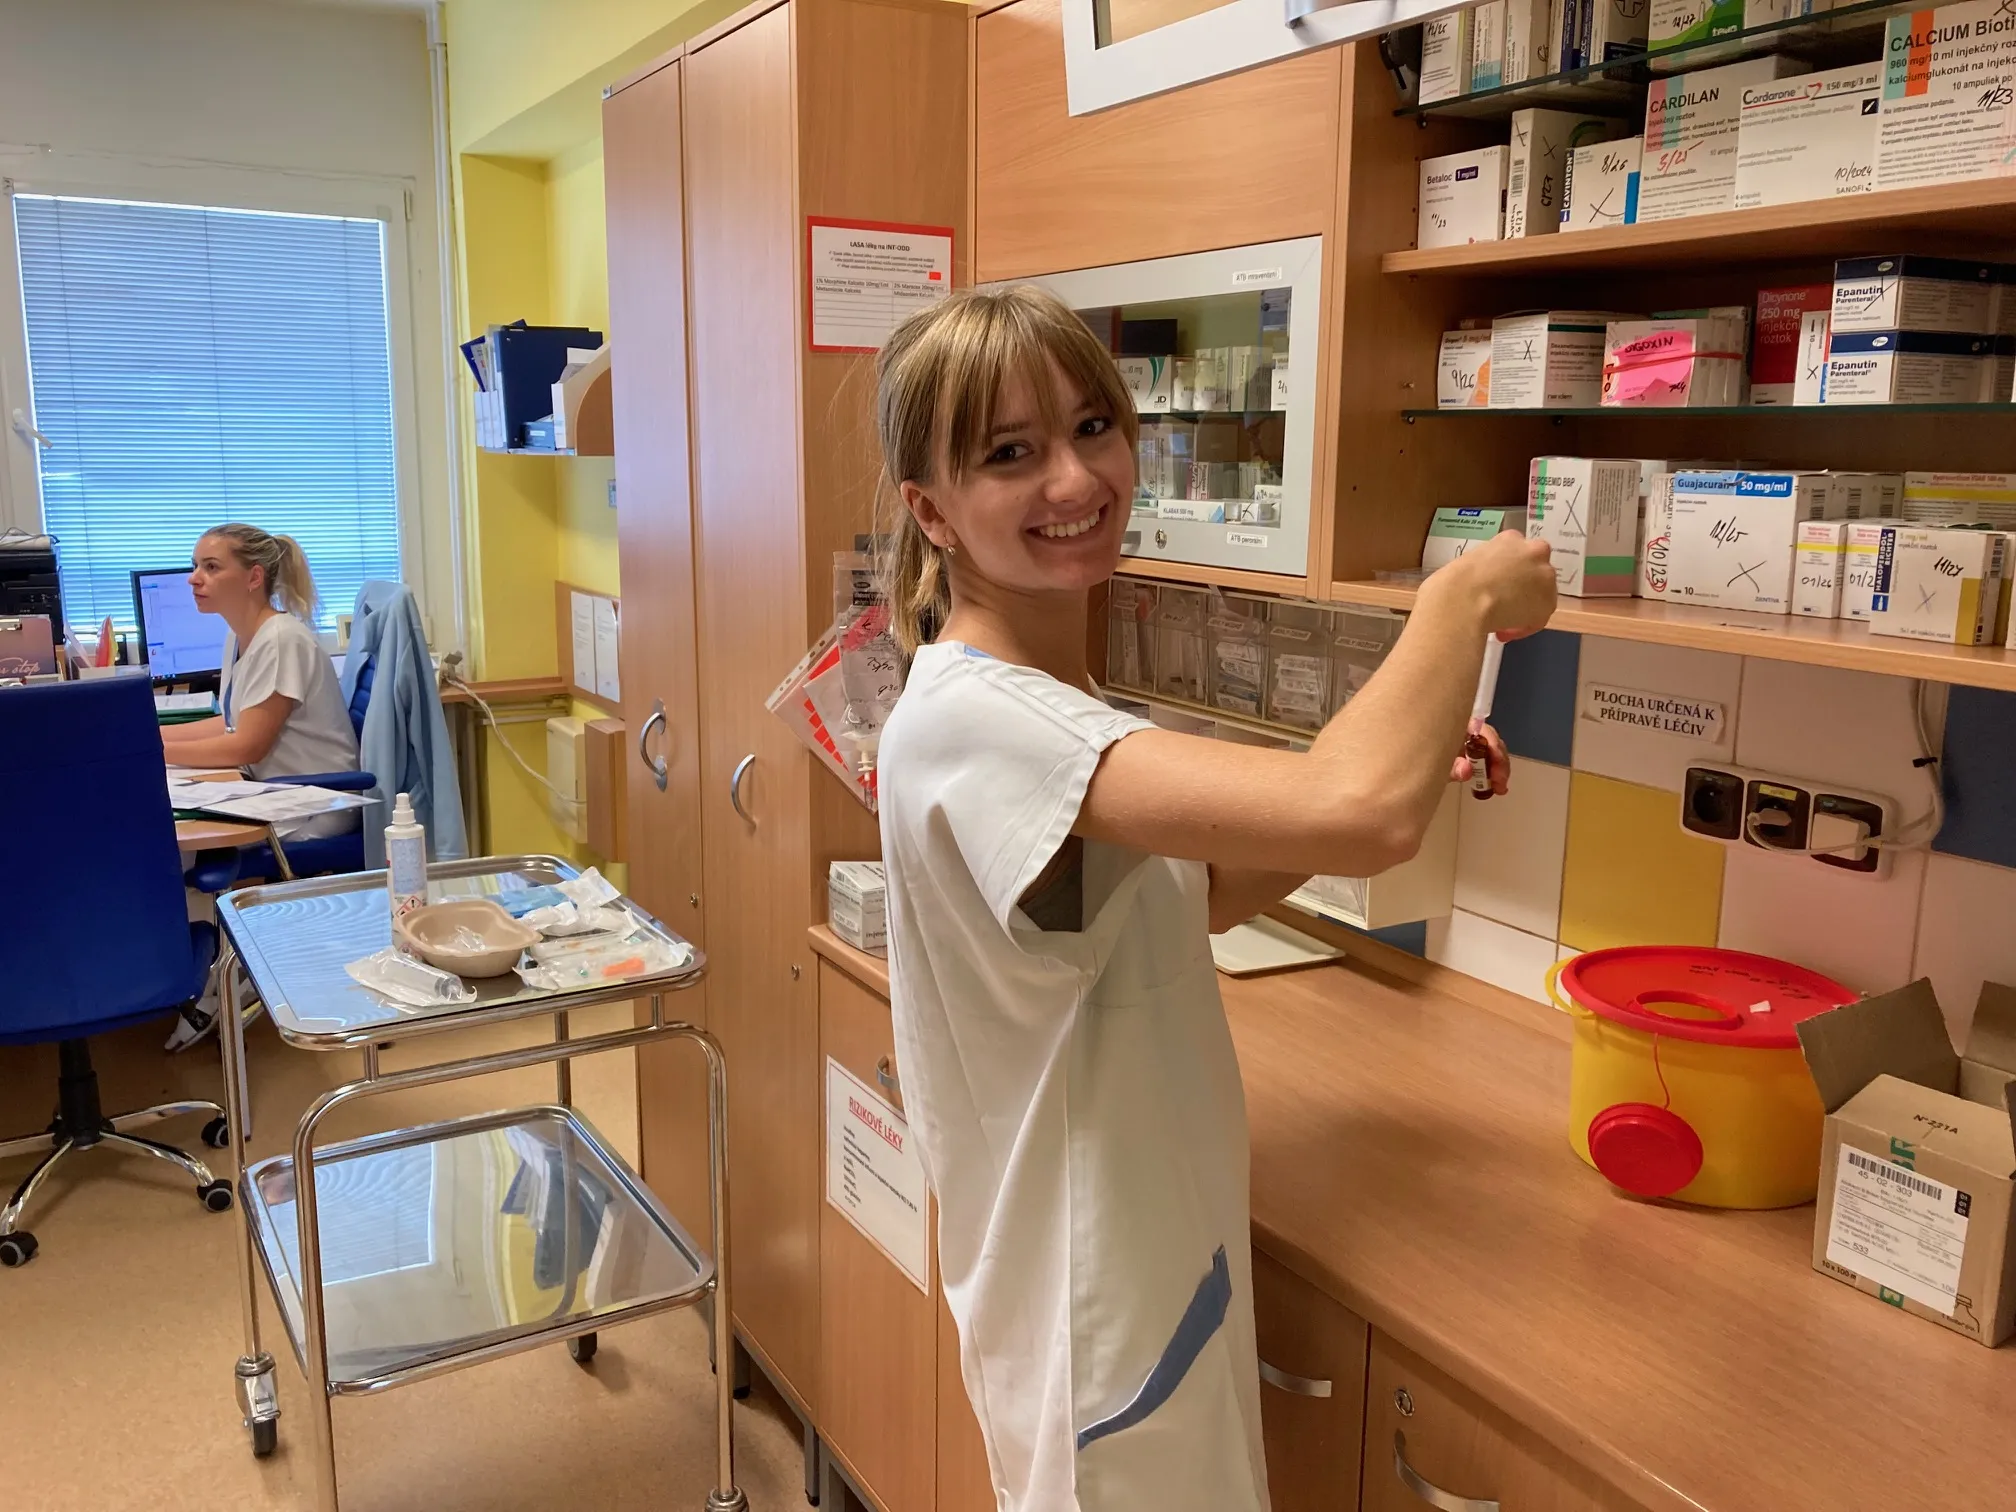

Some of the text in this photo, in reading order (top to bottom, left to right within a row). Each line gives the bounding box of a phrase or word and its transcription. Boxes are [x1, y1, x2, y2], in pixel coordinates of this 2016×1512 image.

[1890, 23, 1970, 52] CALCIUM
[1890, 58, 1907, 70] 960
[1909, 52, 1939, 67] mg/10
[1941, 49, 1954, 61] ml
[1956, 42, 1999, 58] injekčný
[1889, 63, 1969, 85] kalciumglukonát
[1971, 62, 1984, 73] na
[1953, 81, 1961, 91] 10
[2001, 74, 2013, 84] po
[1743, 89, 1797, 105] Cordarone
[1865, 74, 1878, 85] ml
[1650, 88, 1719, 114] CARDILAN
[1426, 173, 1453, 185] Betaloc
[1834, 162, 1873, 182] 10/2024
[1563, 156, 1574, 210] CAVINTON
[1836, 184, 1864, 195] SANOFI
[1836, 285, 1883, 298] Epanutin
[1761, 307, 1801, 319] 250 mg
[1760, 333, 1792, 345] roztok
[1831, 360, 1878, 371] Epanutin
[1530, 476, 1562, 487] FUROSEMID
[1678, 479, 1787, 493] Guajacuran 50 mg/ml
[1231, 535, 1241, 543] ATB
[1884, 532, 1894, 566] RICHTER
[1647, 540, 1670, 587] 10/23
[1875, 533, 1888, 592] HALOPERIDOL
[1684, 587, 1694, 596] 10
[1755, 596, 1781, 604] ZENTIVA
[12, 659, 41, 677] stop
[1594, 690, 1715, 721] PLOCHA URČENÁ K
[1600, 707, 1706, 736] PŘÍPRAVĚ LÉČIV
[849, 1096, 904, 1150] RIZIKOVÉ LÉKY
[1858, 1170, 1869, 1180] 45
[1876, 1178, 1888, 1188] 02
[1895, 1185, 1913, 1198] 303
[1852, 1242, 1869, 1255] 533
[1836, 1266, 1850, 1277] 100
